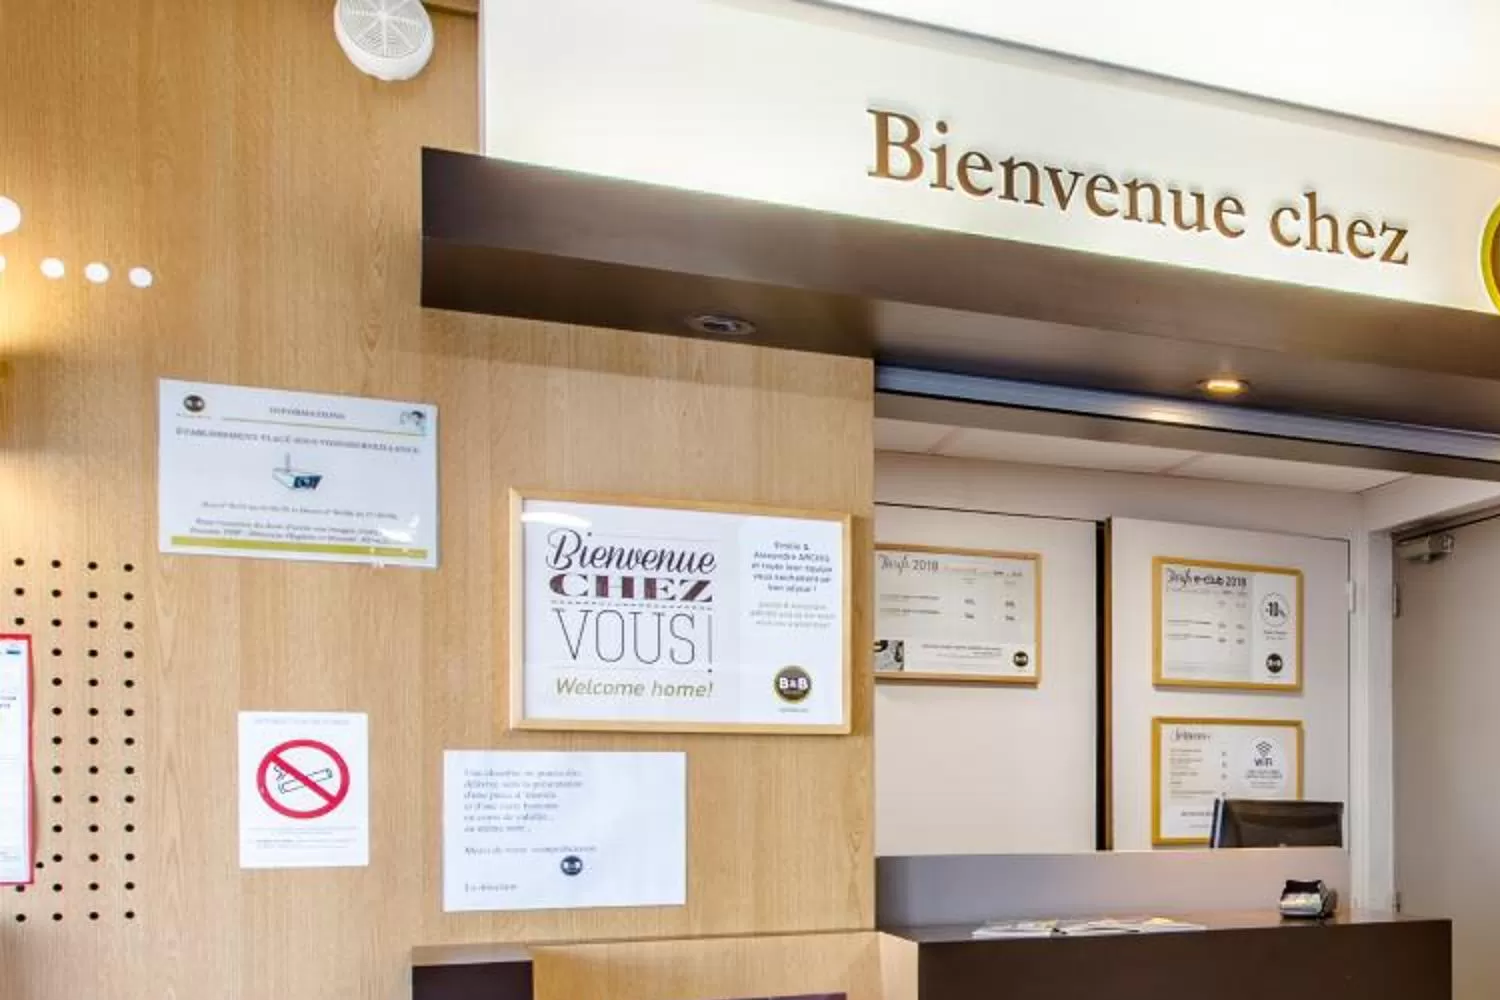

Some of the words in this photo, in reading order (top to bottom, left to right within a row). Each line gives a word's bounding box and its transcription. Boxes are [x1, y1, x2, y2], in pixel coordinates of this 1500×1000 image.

[866, 107, 1246, 239] Bienvenue
[1268, 191, 1410, 266] chez
[546, 527, 717, 575] Bienvenue
[549, 573, 713, 603] CHEZ
[556, 677, 645, 697] Welcome
[651, 681, 714, 698] home!
